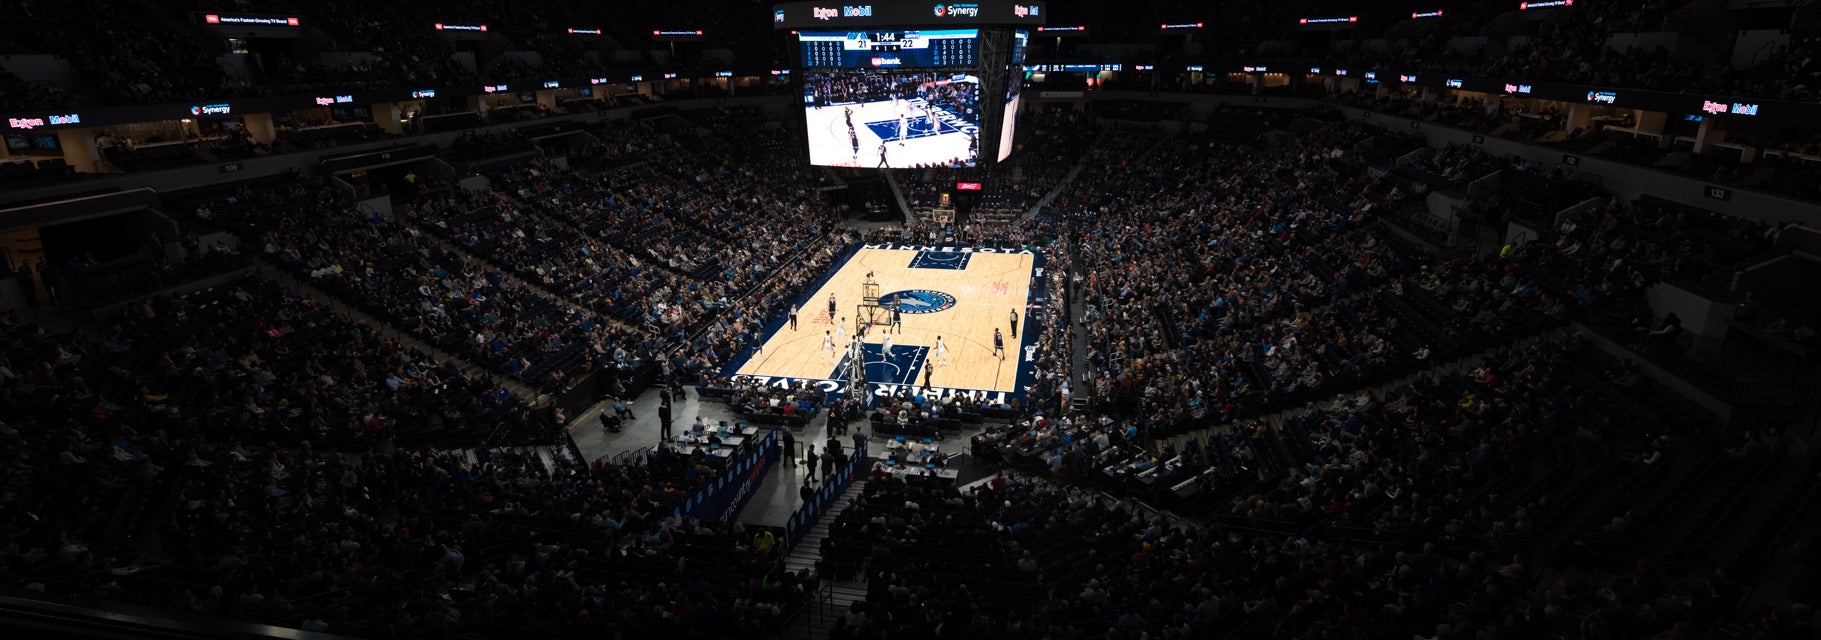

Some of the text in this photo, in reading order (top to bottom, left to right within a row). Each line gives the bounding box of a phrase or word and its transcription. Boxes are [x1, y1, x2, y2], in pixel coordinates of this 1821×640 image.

[813, 6, 871, 20] Exxon Mobil
[948, 6, 978, 17] Synergy
[877, 33, 894, 41] 1:44
[858, 40, 867, 48] 21
[1595, 93, 1616, 104] Synergy
[202, 106, 230, 115] Synergy
[1703, 100, 1758, 115] Exxon Mobil
[9, 114, 80, 129] Exxon Mobil
[862, 243, 1034, 256] MINNESOTA
[730, 374, 1005, 405] TIMBROLVE
